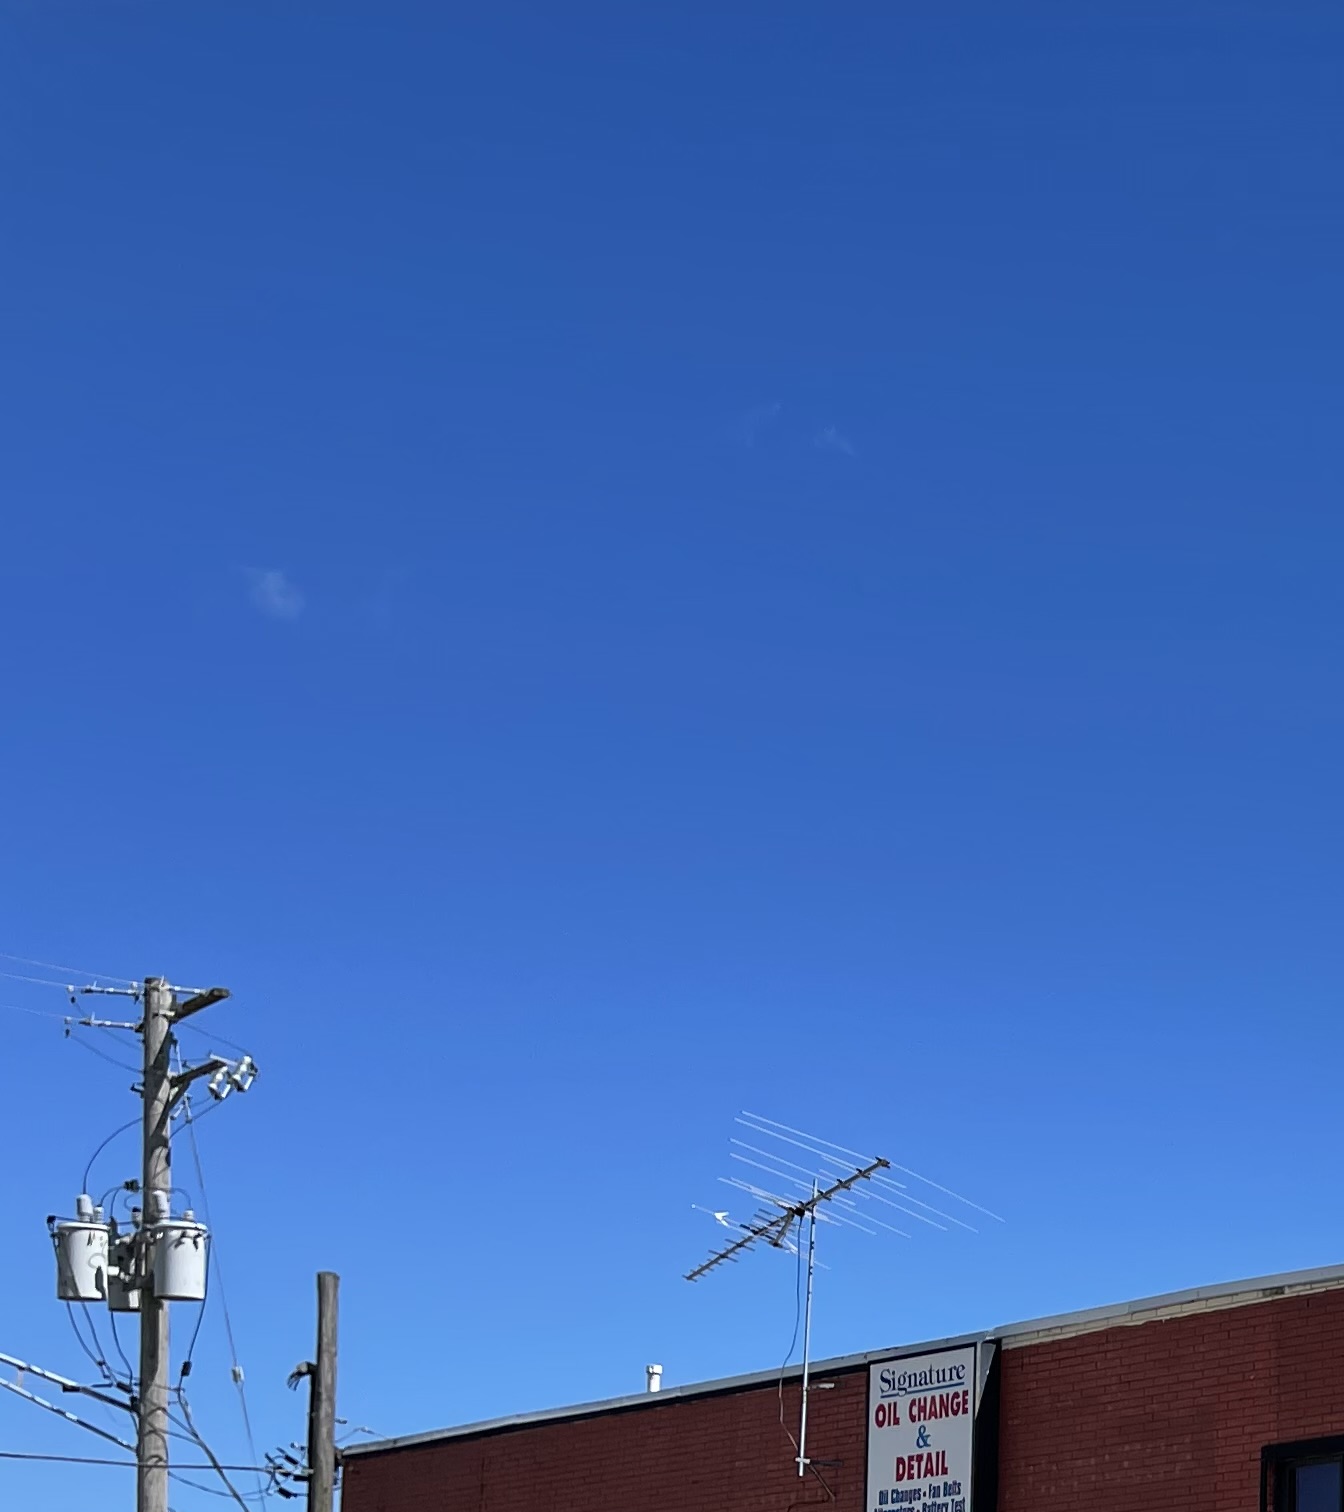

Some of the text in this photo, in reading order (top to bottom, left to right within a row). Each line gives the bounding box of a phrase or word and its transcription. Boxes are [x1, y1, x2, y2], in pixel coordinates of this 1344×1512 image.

[880, 1364, 965, 1396] Signature
[875, 1389, 969, 1428] OIL CHANGE
[916, 1425, 931, 1448] &
[895, 1450, 948, 1482] DETAIL
[879, 1480, 961, 1506] Oil Changes Fan Belts
